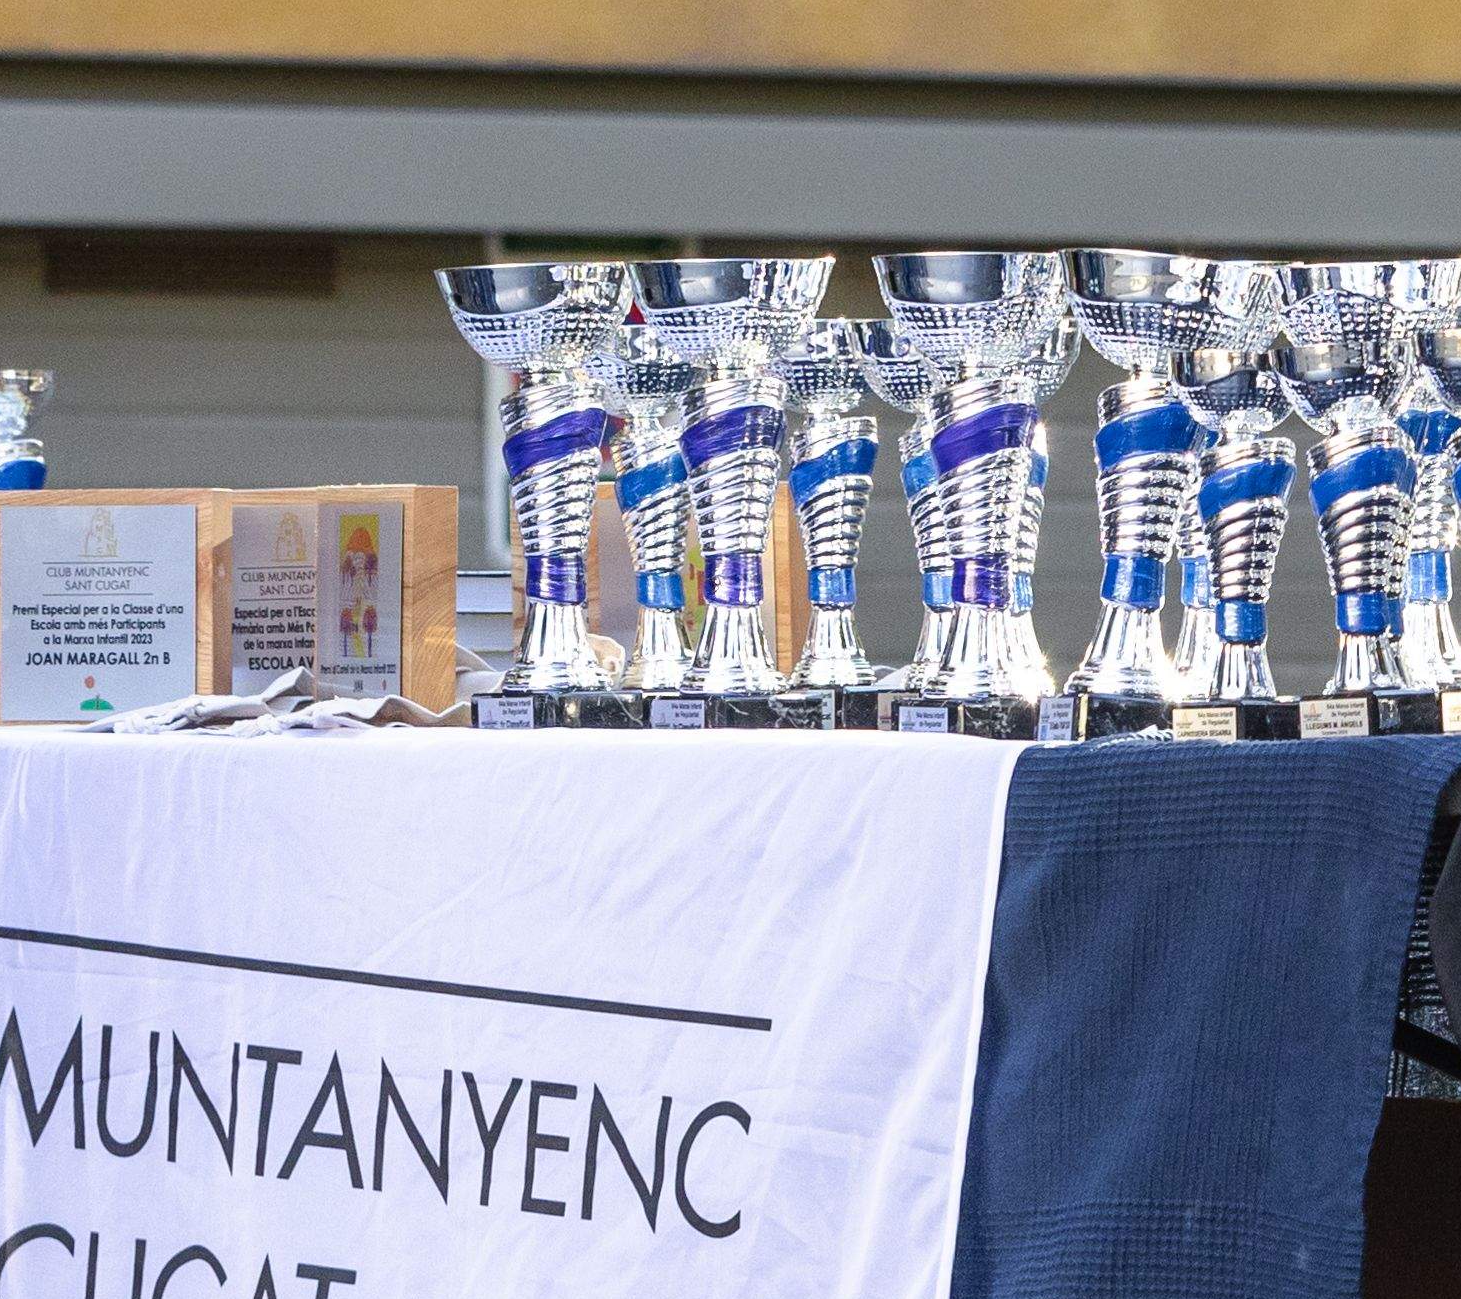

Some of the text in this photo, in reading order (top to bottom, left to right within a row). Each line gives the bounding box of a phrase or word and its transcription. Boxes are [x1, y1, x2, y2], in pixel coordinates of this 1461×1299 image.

[46, 566, 149, 577] CLUB MUNTANYENC
[241, 573, 266, 583] CLUB
[65, 580, 131, 591] SANT CUGAT
[260, 585, 284, 596] SANT
[12, 604, 39, 615] Premi
[42, 604, 81, 617] Especial
[83, 606, 99, 617] per
[111, 603, 120, 615] la
[122, 603, 153, 615] Classe
[235, 607, 268, 620] Especial
[270, 609, 284, 620] per
[31, 618, 166, 632] Escola amb més Participants
[266, 623, 285, 634] amb
[52, 634, 62, 645] la
[64, 634, 94, 645] Marxa
[97, 634, 128, 645] Infantil
[131, 633, 153, 644] 2023
[244, 639, 254, 650] de
[257, 639, 265, 650] la
[267, 640, 293, 650] marxa
[25, 652, 171, 666] JOAN MARAGALL 2n B
[249, 658, 295, 671] ESCOLA
